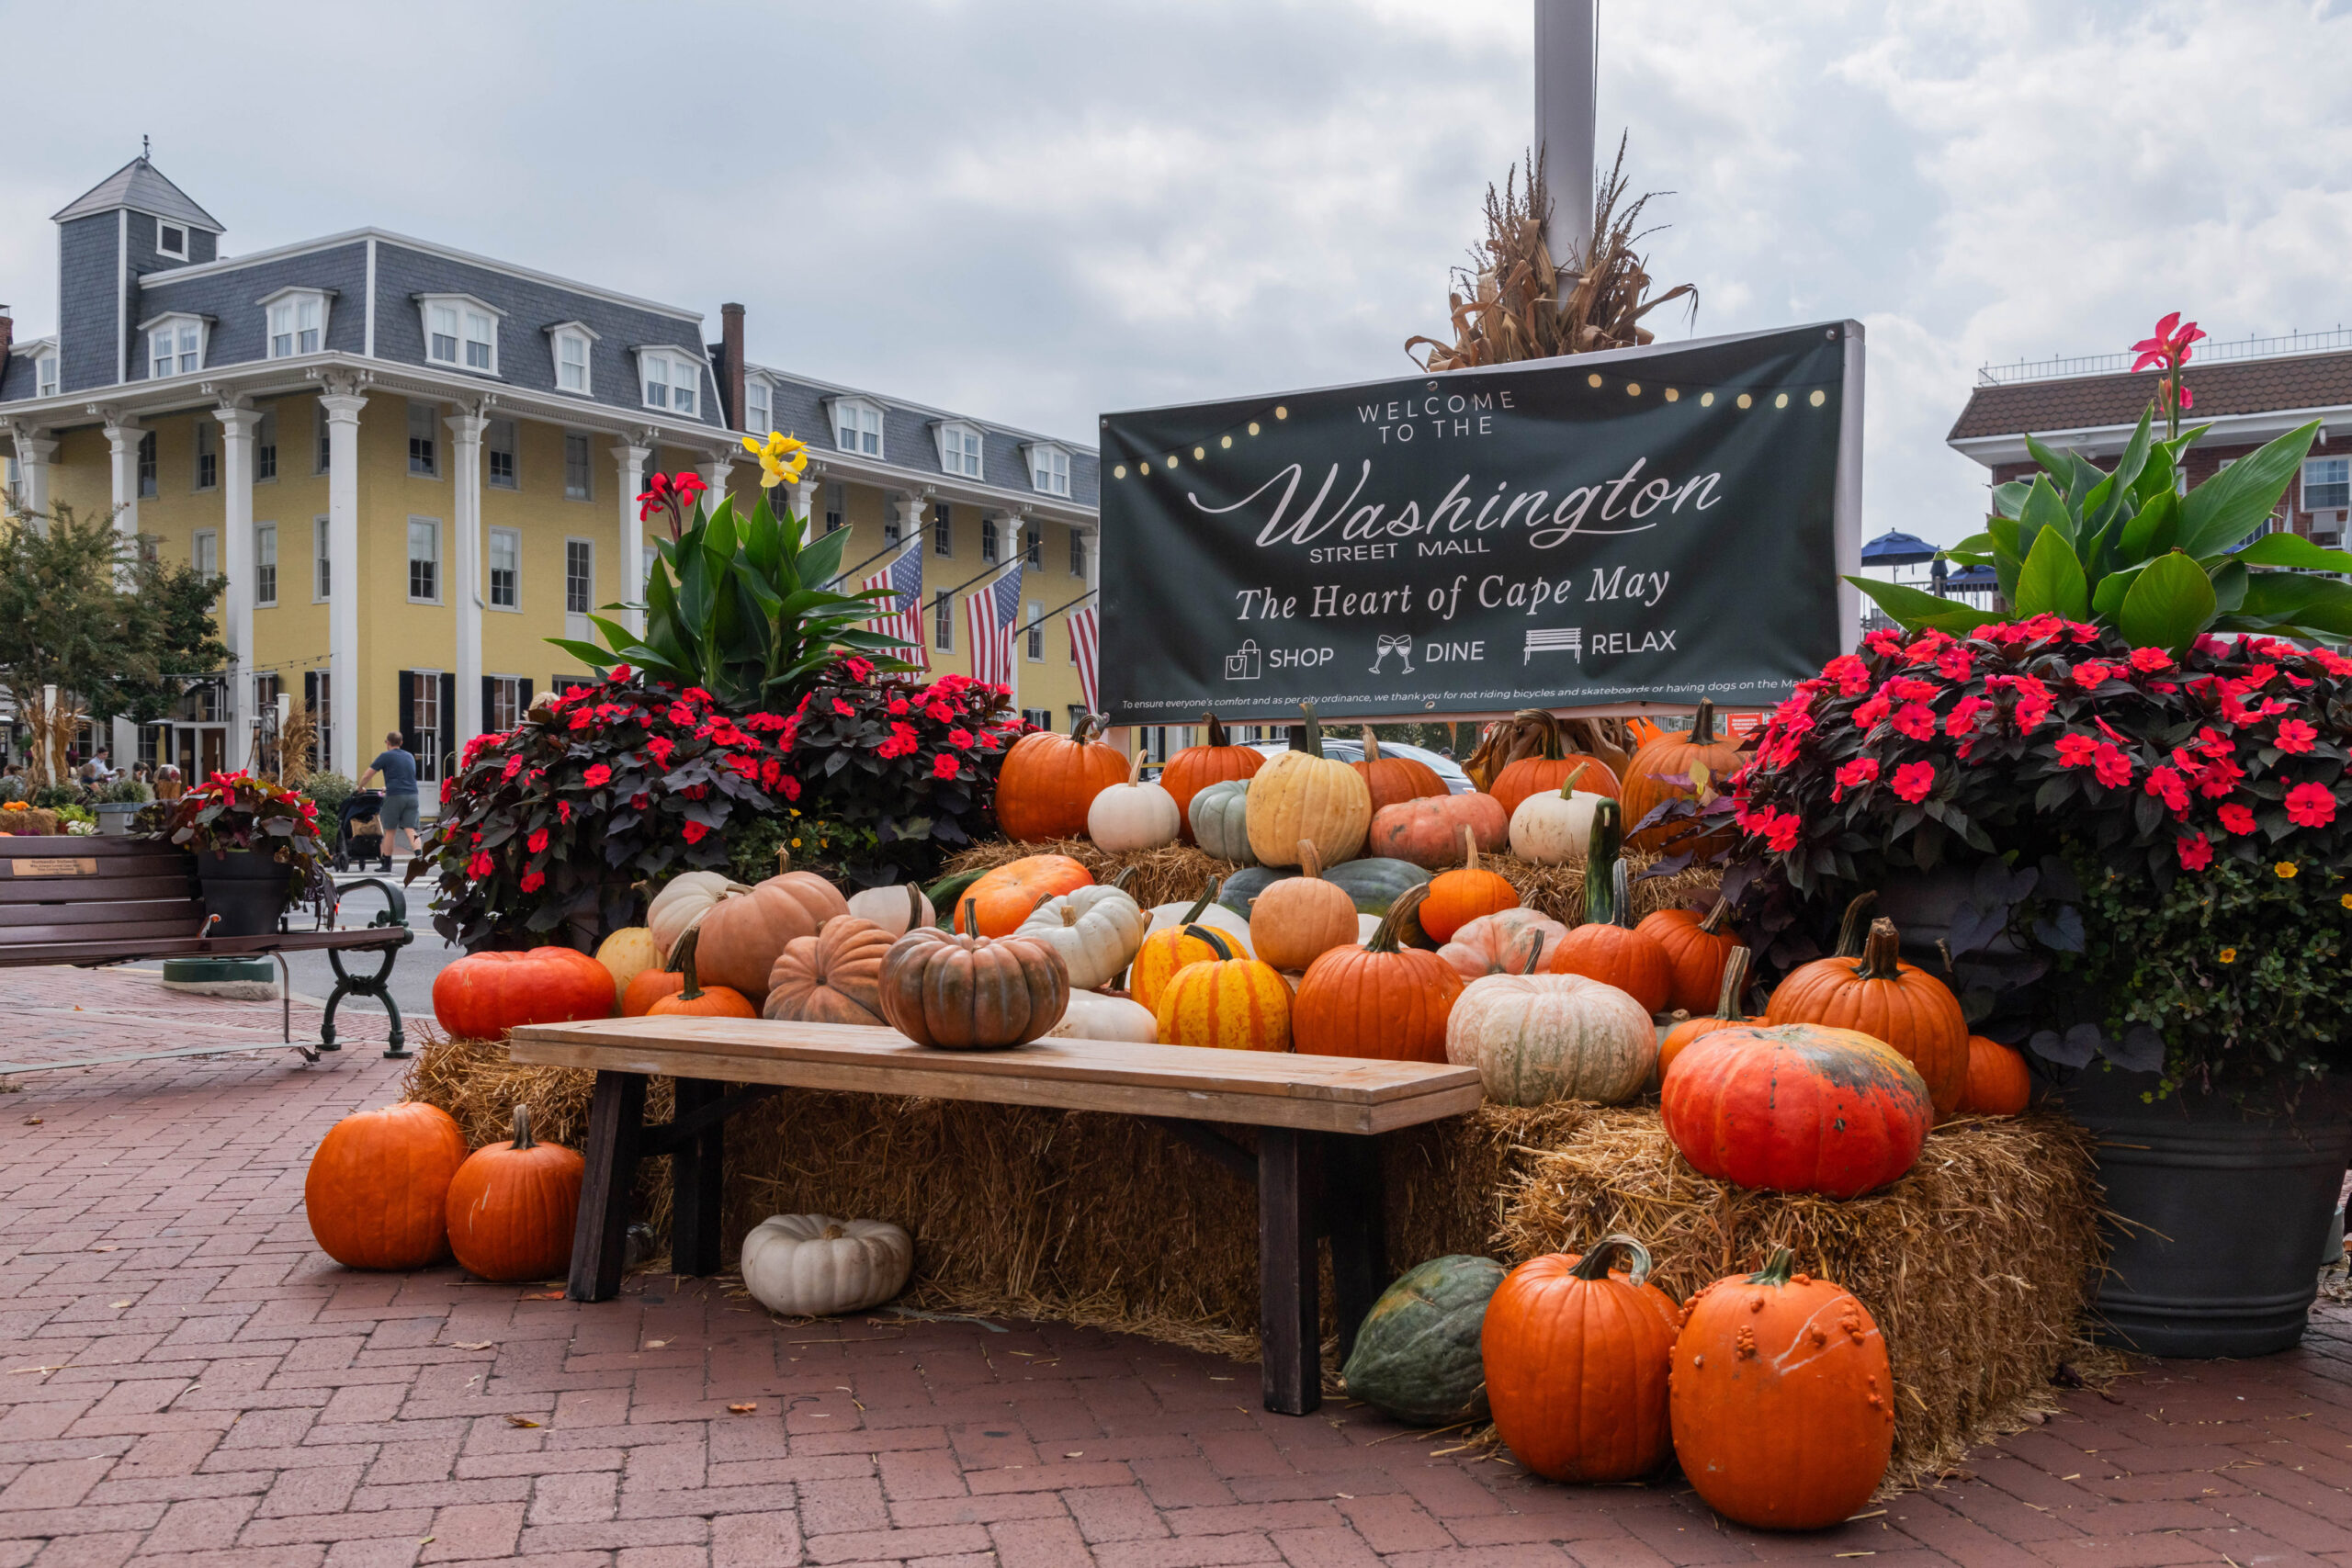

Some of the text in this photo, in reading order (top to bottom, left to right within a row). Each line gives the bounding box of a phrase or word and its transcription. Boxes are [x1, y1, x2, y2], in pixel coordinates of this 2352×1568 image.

[1358, 391, 1515, 423] WELCOME
[1378, 416, 1492, 444] TO THE
[1188, 457, 1722, 549] Washington
[1309, 538, 1490, 563] STREET MALL
[1236, 566, 1669, 620] The Heart of Cape May
[1426, 641, 1485, 662] DINE
[1592, 630, 1677, 655] RELAX
[1270, 648, 1334, 668] SHOP
[1123, 700, 1133, 709] To
[1165, 697, 1213, 709] everyone's
[1215, 696, 1250, 706] comfort
[1252, 695, 1271, 705] and
[1272, 696, 1283, 705] as
[1284, 697, 1302, 706] per
[1303, 694, 1319, 705] city
[1321, 693, 1372, 704] ordinance,
[1374, 694, 1389, 702] we
[1391, 691, 1420, 701] thank
[1421, 693, 1442, 703] you
[1443, 690, 1458, 700] for
[1460, 691, 1478, 700] not
[1480, 689, 1510, 700] riding
[1513, 688, 1555, 699] bicycles
[1557, 687, 1578, 697] and
[1581, 684, 1649, 696] skateboards
[1651, 685, 1664, 694] or
[1667, 682, 1705, 694] having
[1708, 681, 1737, 693] dogs
[1739, 681, 1755, 690] on
[1757, 679, 1778, 689] the
